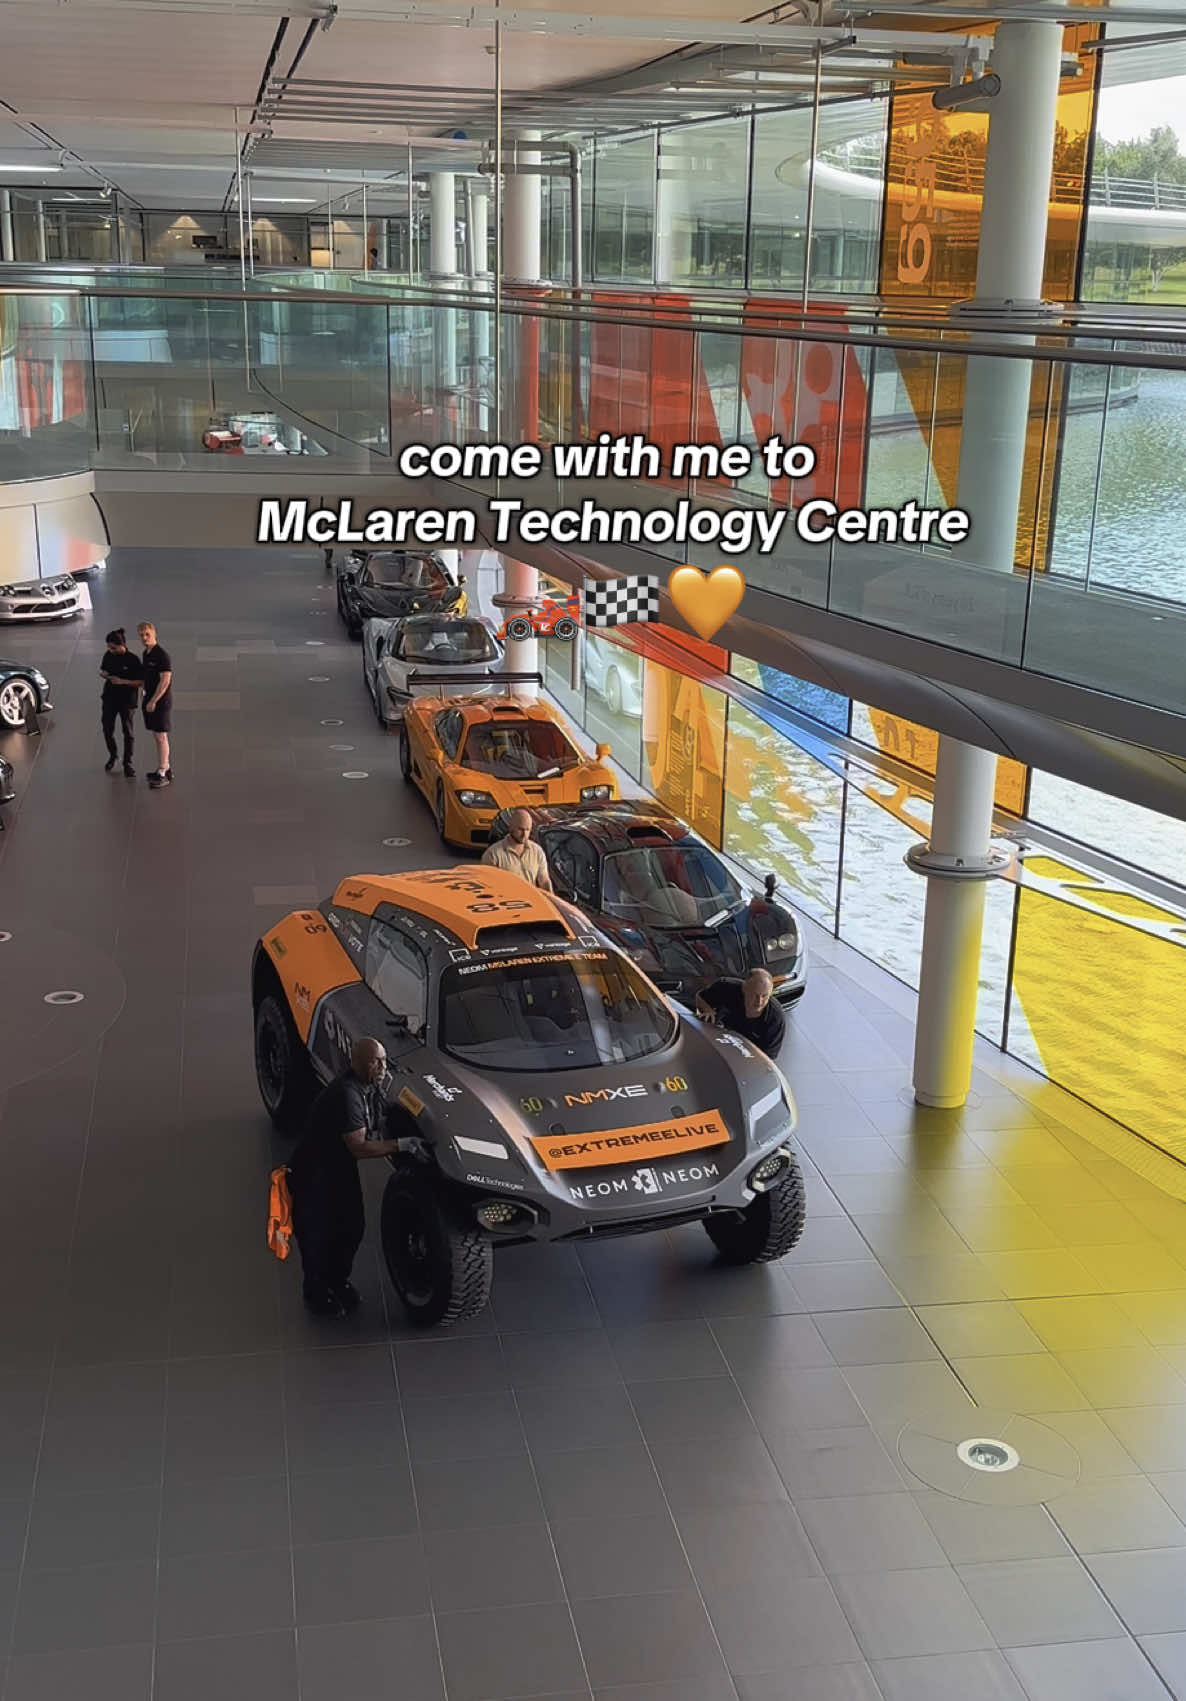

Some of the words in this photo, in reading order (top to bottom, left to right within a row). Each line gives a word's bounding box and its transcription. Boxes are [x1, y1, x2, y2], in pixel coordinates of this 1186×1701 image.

[564, 1084, 649, 1107] NMXE
[665, 1075, 688, 1092] 60
[548, 1123, 719, 1159] @EXTREMEELIVE
[569, 1179, 629, 1200] NEOM
[662, 1164, 720, 1185] NEOM
